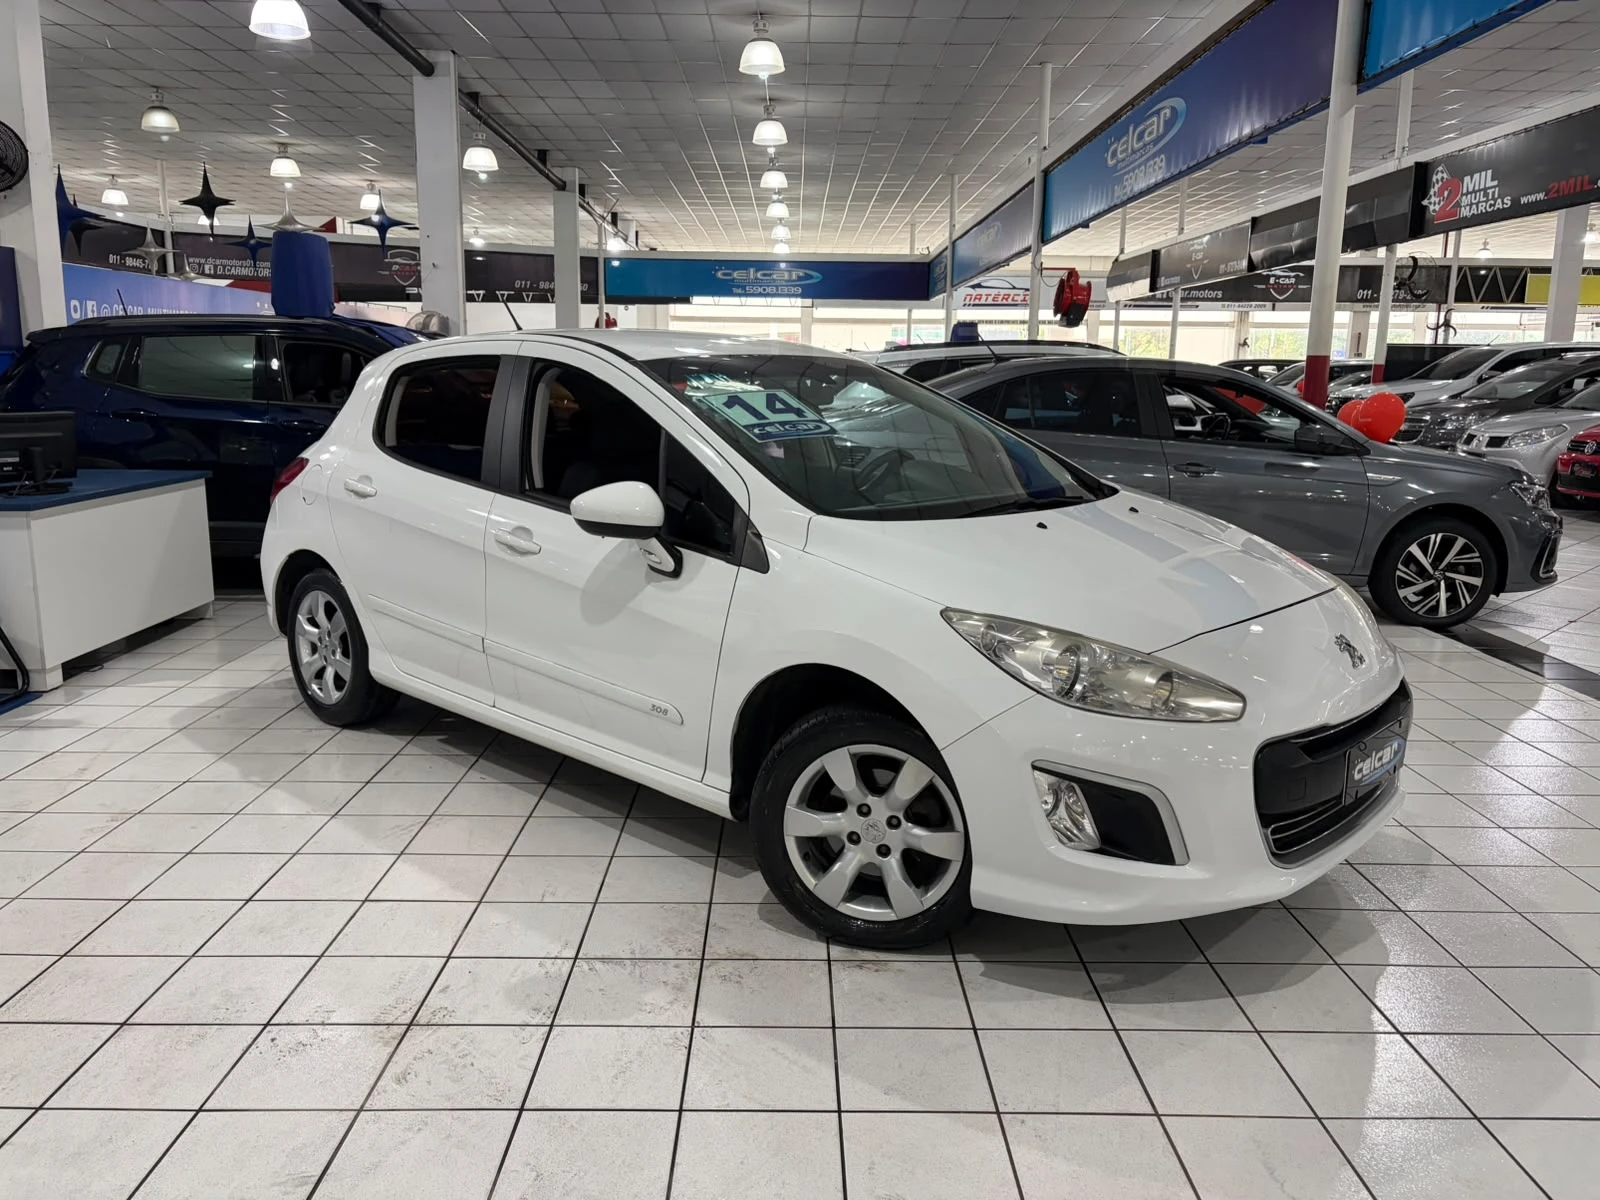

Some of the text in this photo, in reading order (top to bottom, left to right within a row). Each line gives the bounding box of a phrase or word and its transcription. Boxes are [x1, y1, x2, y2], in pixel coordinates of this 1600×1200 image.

[1107, 105, 1171, 168] celcar
[1434, 169, 1498, 223] 2 MIL
[1460, 187, 1499, 206] MULTI
[1460, 196, 1511, 218] MARCAS
[109, 253, 120, 265] 011
[716, 267, 806, 280] celcar
[515, 280, 531, 289] 011
[1168, 288, 1223, 299] ear.motors
[1357, 289, 1372, 299] 011
[722, 392, 808, 421] 14
[752, 422, 817, 434] celcar
[650, 703, 669, 716] 308
[1354, 742, 1398, 781] celcar
